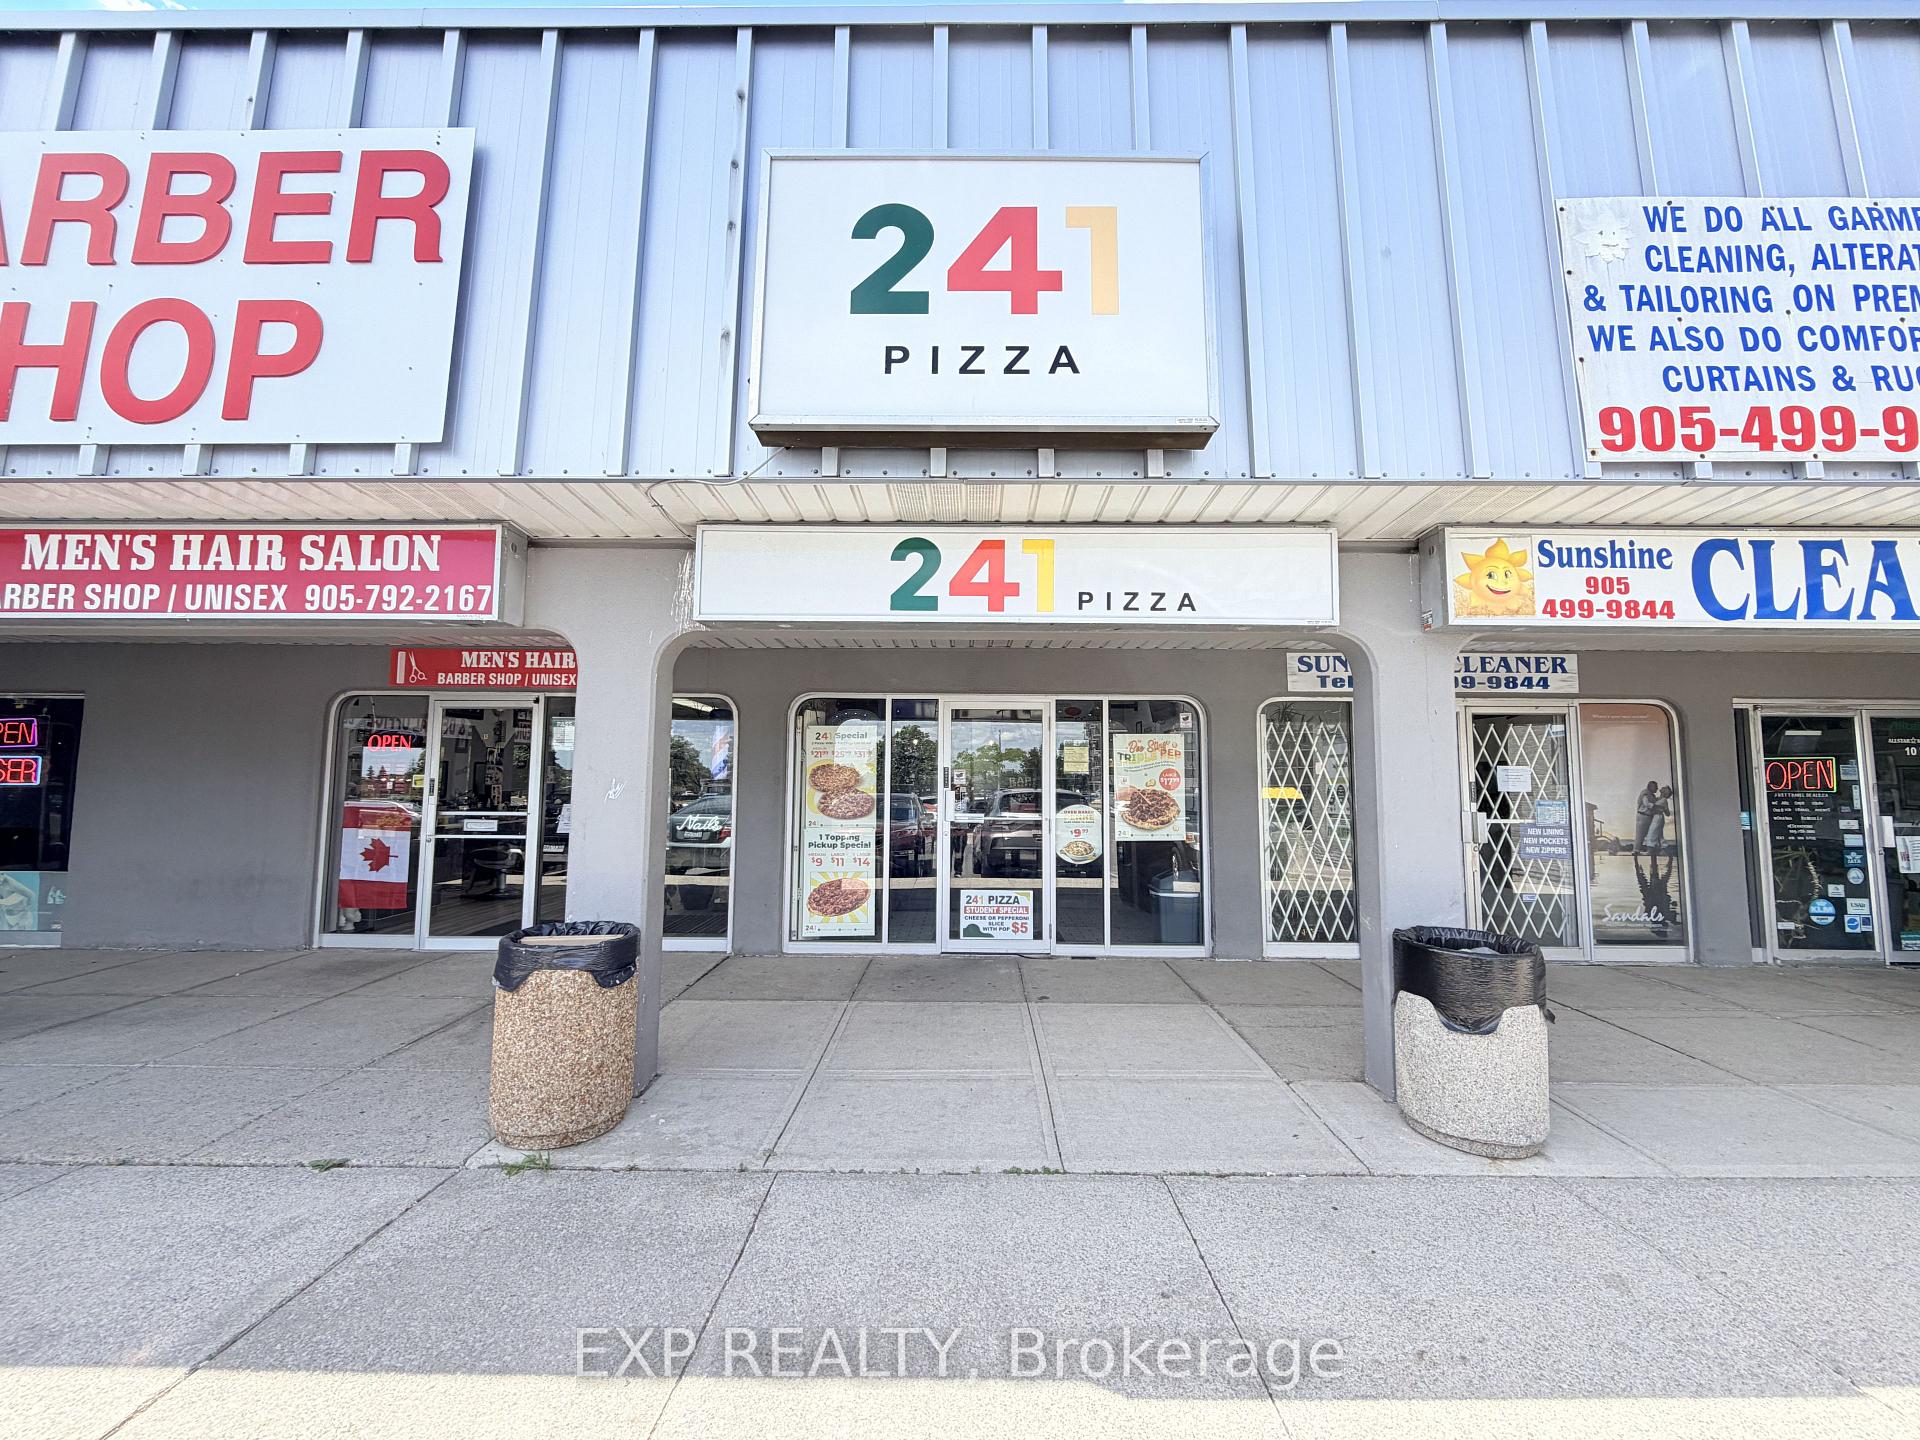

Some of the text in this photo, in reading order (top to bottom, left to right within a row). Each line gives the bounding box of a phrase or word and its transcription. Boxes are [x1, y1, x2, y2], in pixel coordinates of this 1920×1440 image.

[0, 150, 451, 266] RBER
[1643, 206, 1688, 232] WE
[1705, 206, 1744, 232] DO
[1761, 206, 1812, 233] ALL
[850, 203, 1120, 315] 241
[1645, 244, 1795, 277] CLEANING,
[1584, 285, 1606, 312] &
[1619, 285, 1773, 313] TAILORING
[1793, 284, 1836, 312] ON
[1587, 325, 1636, 351] WE
[1649, 326, 1725, 352] ALSO
[1739, 326, 1782, 352] DO
[884, 345, 1081, 374] PIZZA
[1662, 365, 1920, 392] CURTAINS & RU
[21, 534, 441, 572] MEN'S HAIR SALON
[1537, 540, 1673, 570] Sunshine
[889, 537, 1197, 612] 241 PIZZA
[1585, 576, 1631, 595] 905
[0, 583, 492, 613] RBER SHOP / UNISEX 905-792-2167
[1541, 599, 1675, 619] 499-9844
[461, 651, 576, 669] MEN'S HAIR
[1454, 656, 1569, 674] LEANER
[437, 672, 577, 686] BARBER SHOP / UNISEX
[368, 734, 412, 752] OPEN
[1160, 749, 1182, 758] PEP
[1904, 747, 1917, 756] 10
[1766, 760, 1834, 790] OPEN
[676, 815, 722, 831] Nails
[811, 857, 870, 867] $9 $11 $14
[966, 895, 1020, 904] 241 PIZZA
[1602, 904, 1664, 922] Sandals
[1012, 922, 1028, 935] $5
